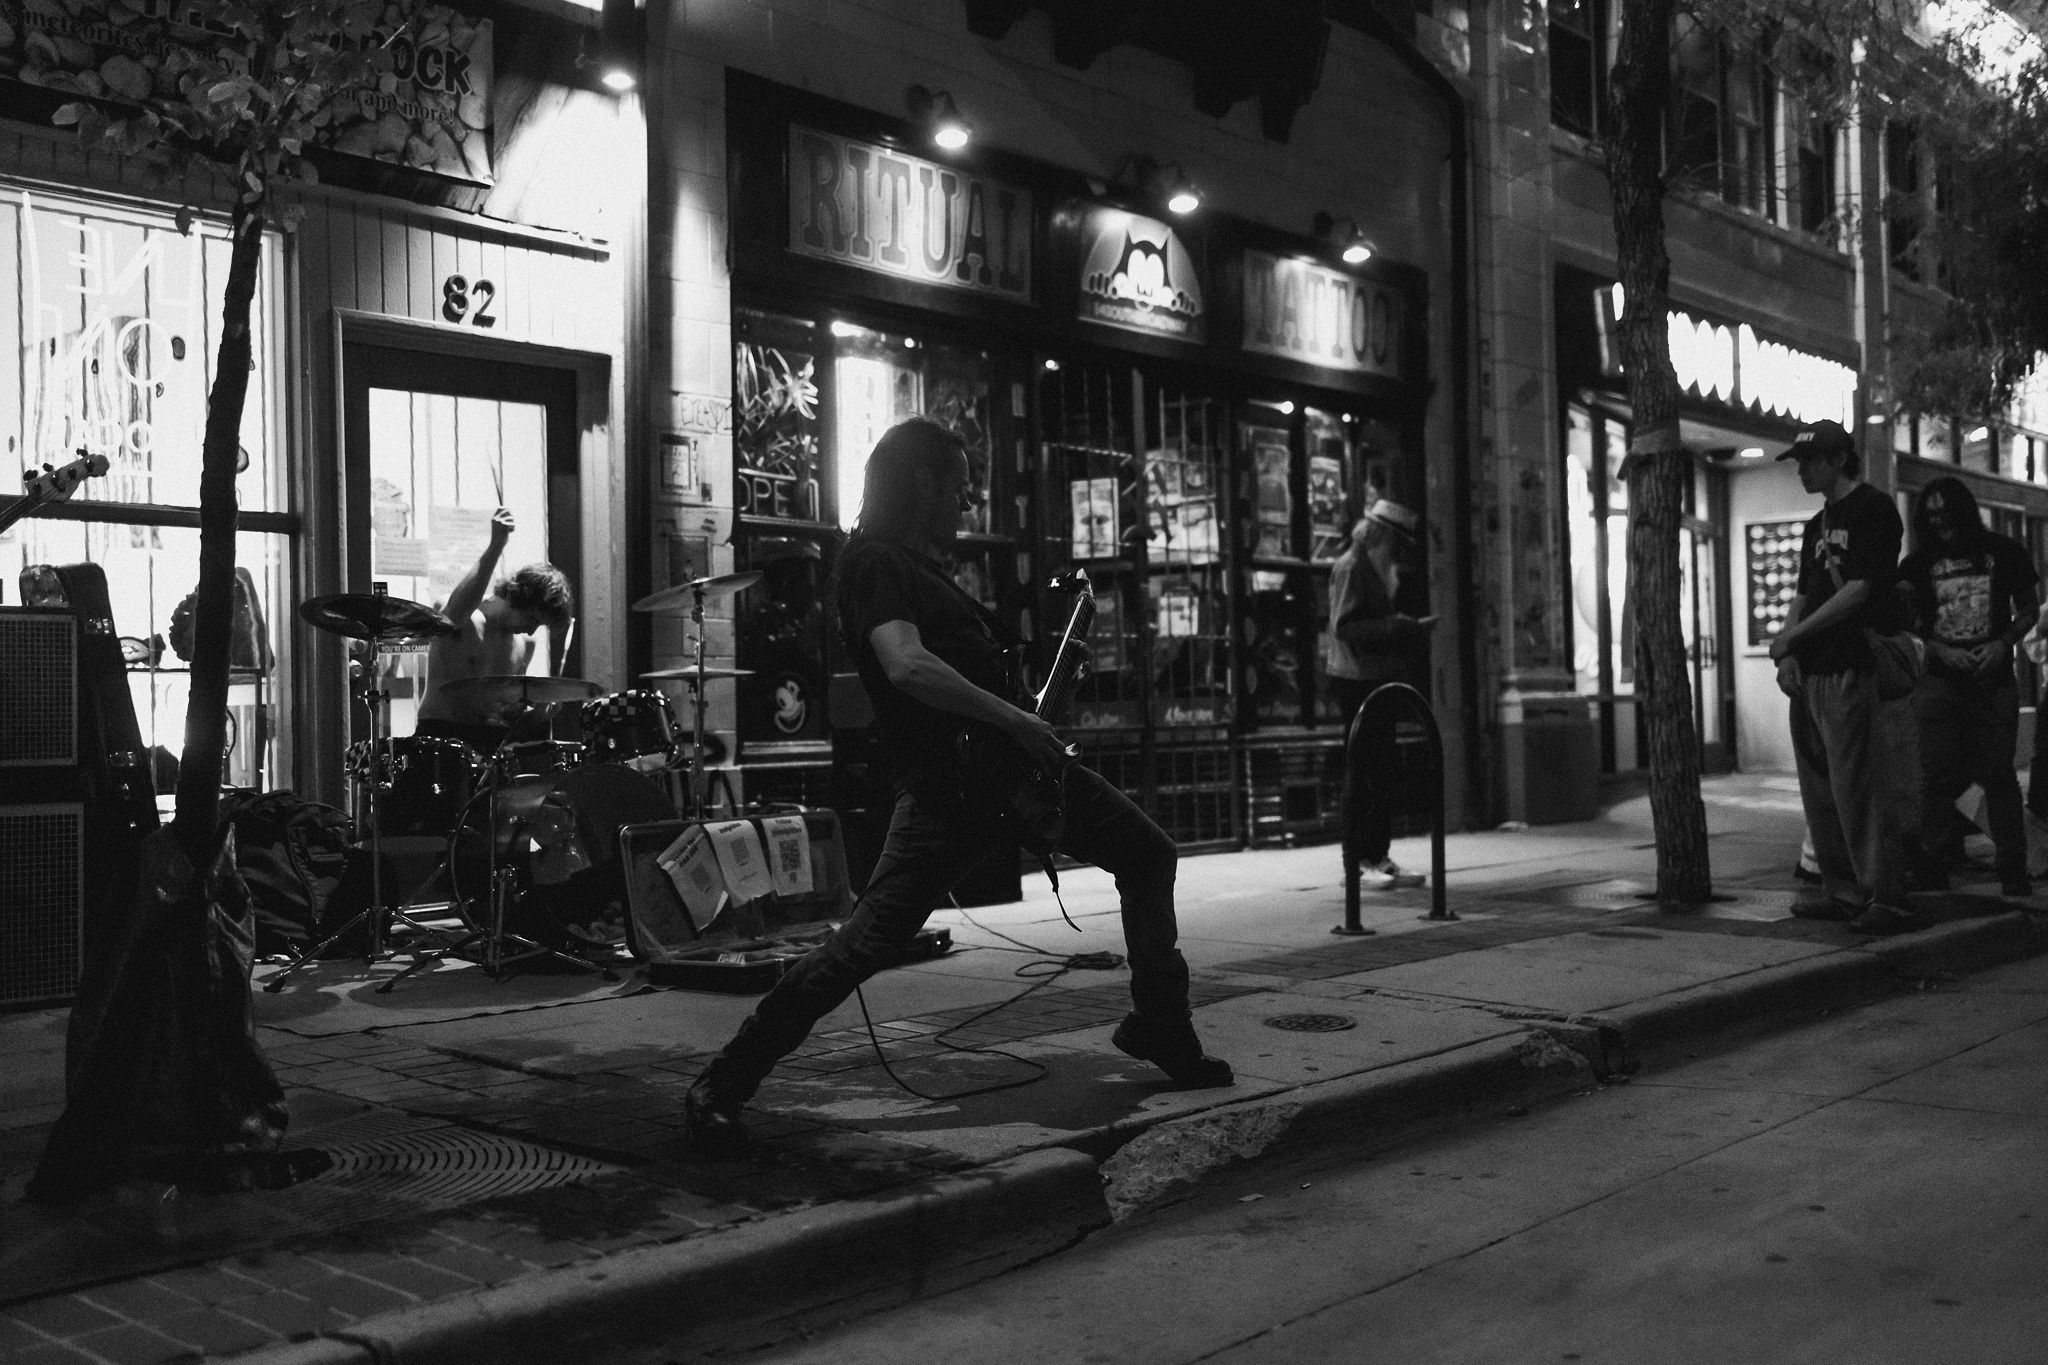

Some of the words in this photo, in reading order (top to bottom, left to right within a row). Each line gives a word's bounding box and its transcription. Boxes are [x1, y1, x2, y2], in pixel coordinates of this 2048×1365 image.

[801, 131, 1028, 294] RITUAL
[442, 274, 496, 328] 82
[1248, 254, 1390, 367] TATTOO
[402, 644, 411, 654] ON
